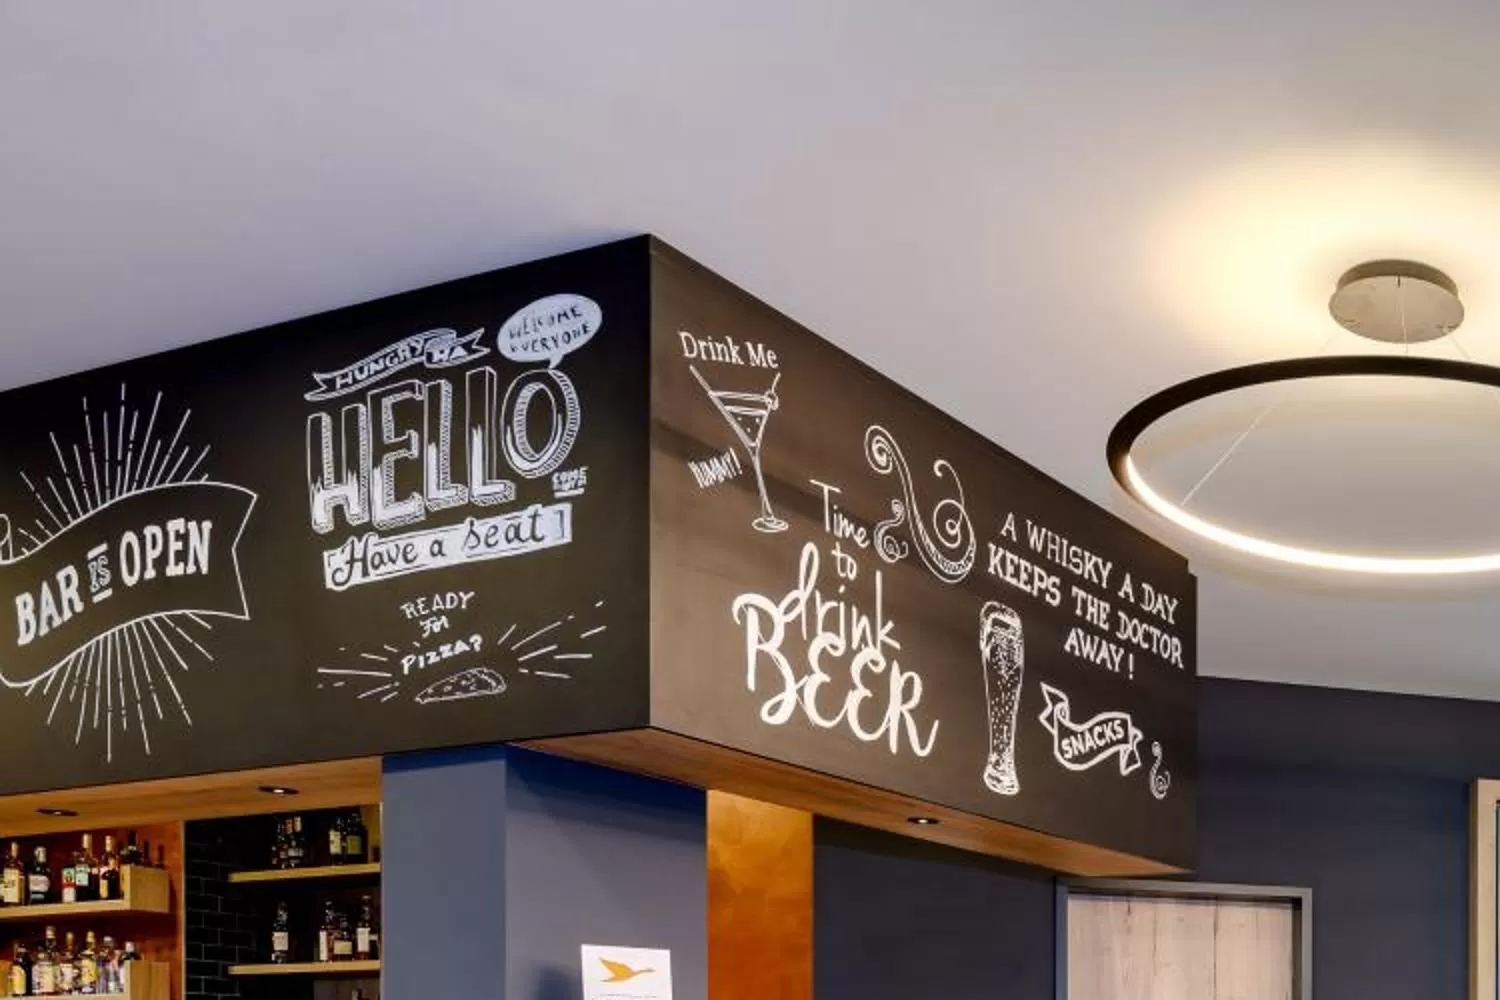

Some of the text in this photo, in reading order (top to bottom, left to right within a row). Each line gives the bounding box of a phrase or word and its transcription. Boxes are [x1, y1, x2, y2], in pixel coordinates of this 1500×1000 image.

[334, 337, 424, 390] HUNGRY
[677, 331, 779, 369] Drink Me
[306, 366, 582, 535] HELLO
[331, 511, 545, 586] Have a seat
[809, 479, 869, 549] Time
[15, 565, 84, 647] BAR
[119, 517, 213, 587] OPEN
[779, 541, 901, 650] drink
[832, 541, 856, 581] to
[1001, 512, 1179, 625] A WHISKY A DAY
[400, 591, 475, 619] READY
[988, 542, 1184, 669] KEEPS THE DOCTOR
[401, 634, 483, 676] PIZZA?
[1061, 719, 1125, 759] SNACKS
